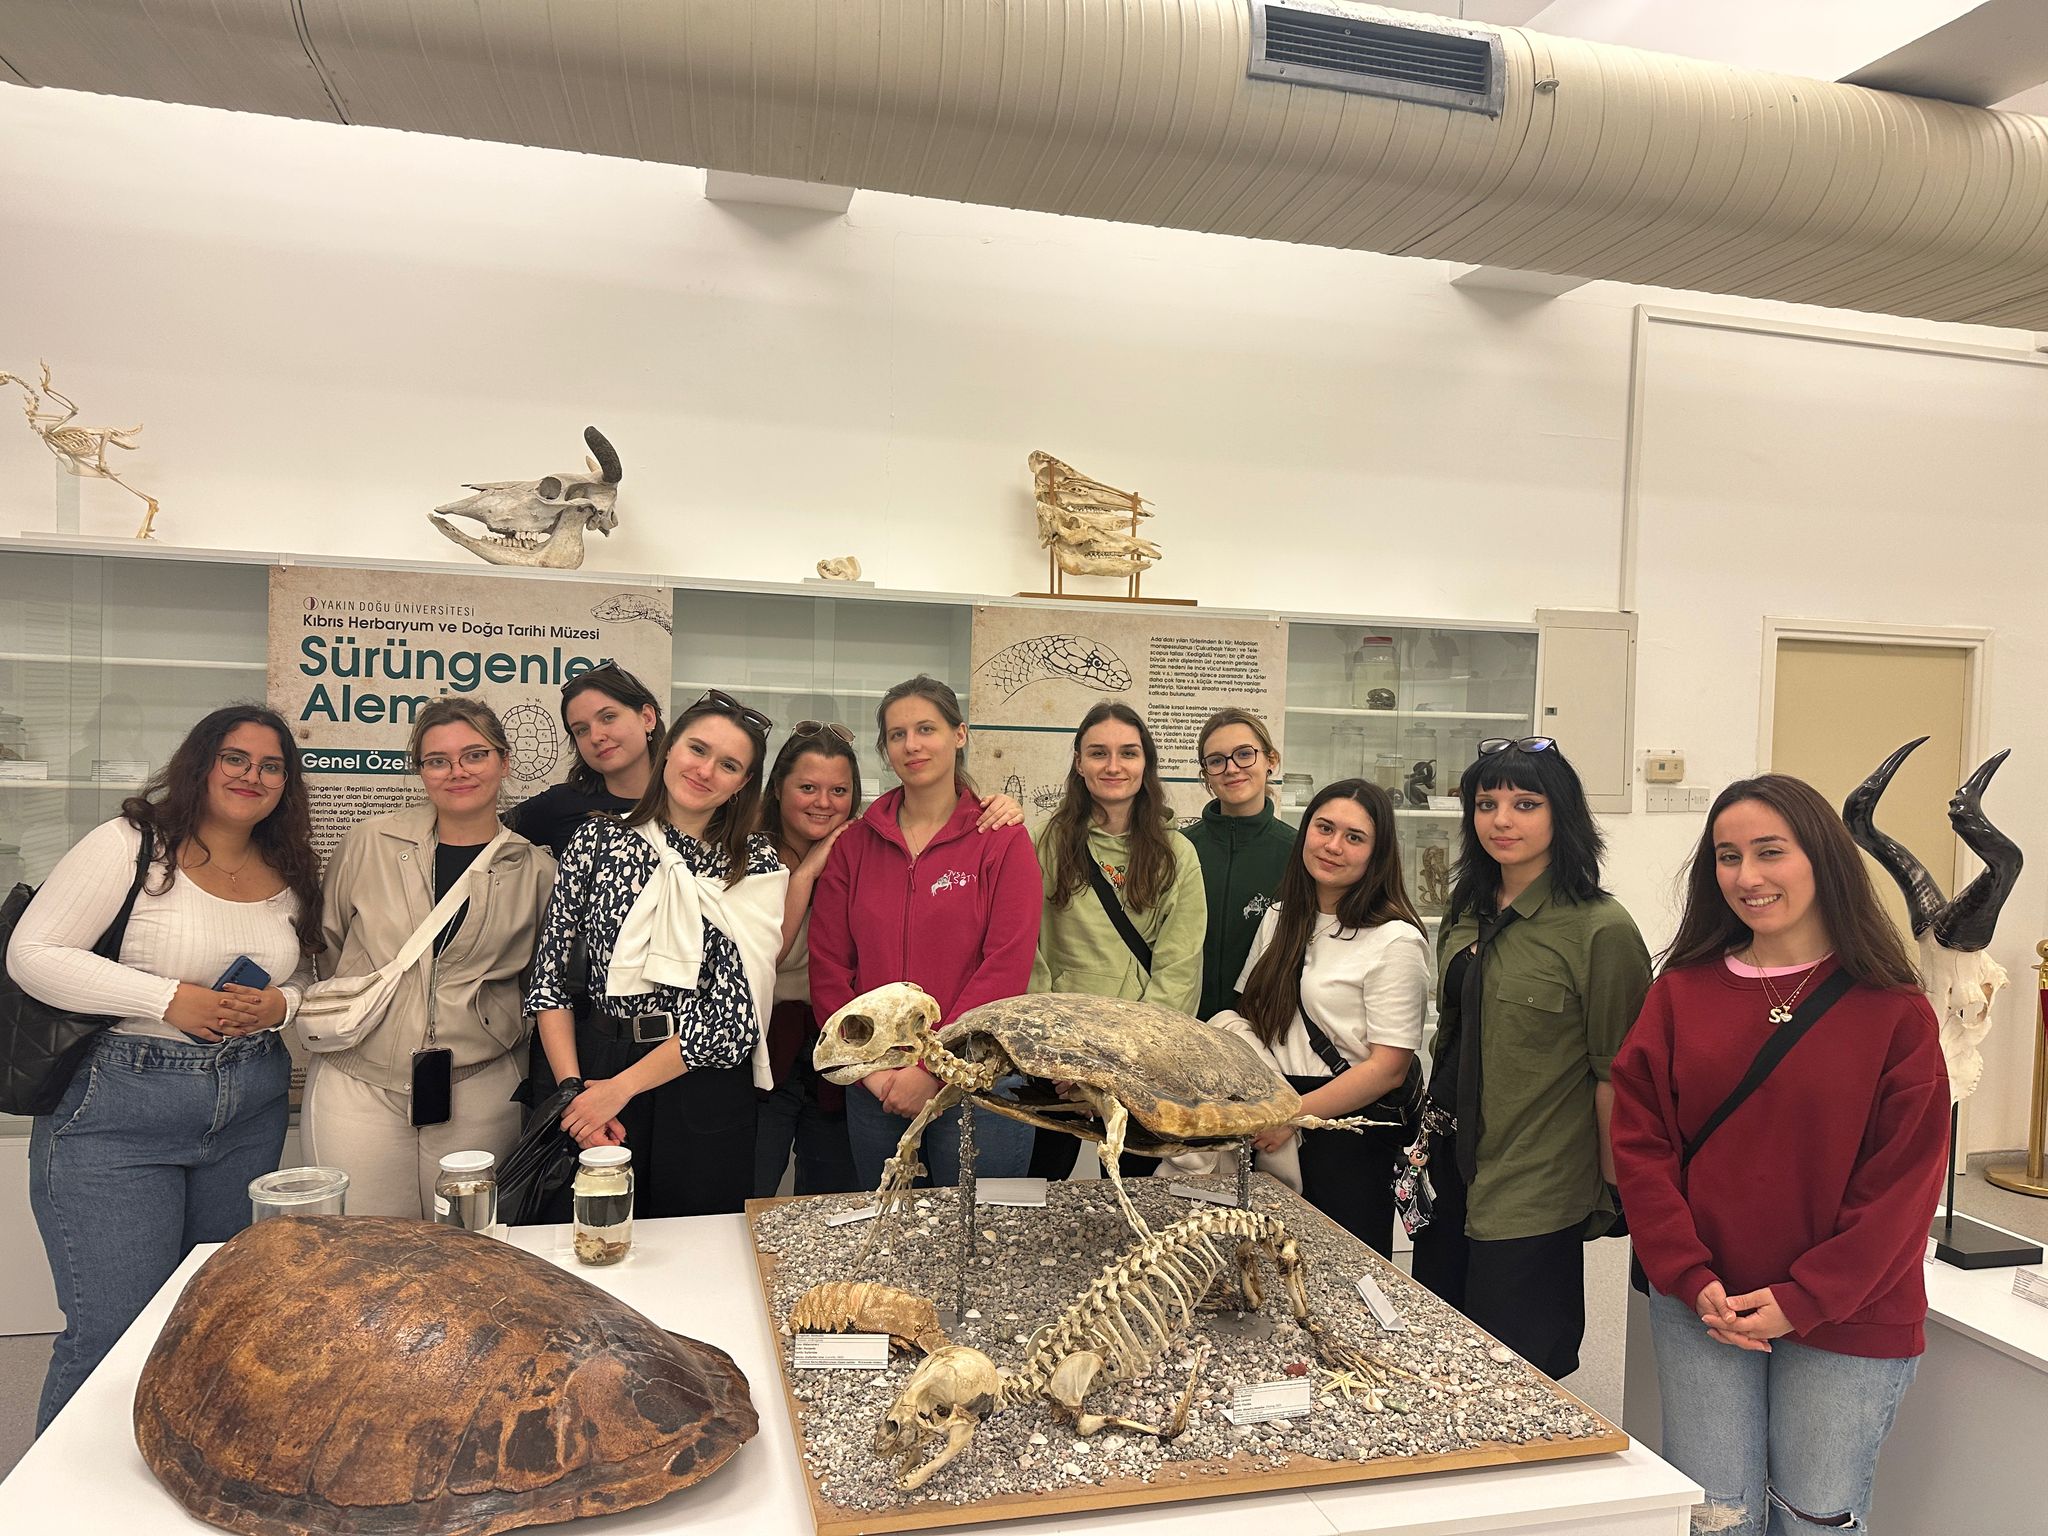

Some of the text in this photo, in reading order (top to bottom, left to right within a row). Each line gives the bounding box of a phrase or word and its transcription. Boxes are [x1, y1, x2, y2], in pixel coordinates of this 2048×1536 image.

[321, 600, 474, 616] YAKIN DOĞU ÜNİVERSİTESİ
[303, 614, 600, 640] Kıbrıs Herbaryum ve Doğa Tarihi Müzesi
[299, 636, 613, 692] Sürüngenle
[299, 684, 448, 724] Alem
[301, 753, 360, 770] Genel
